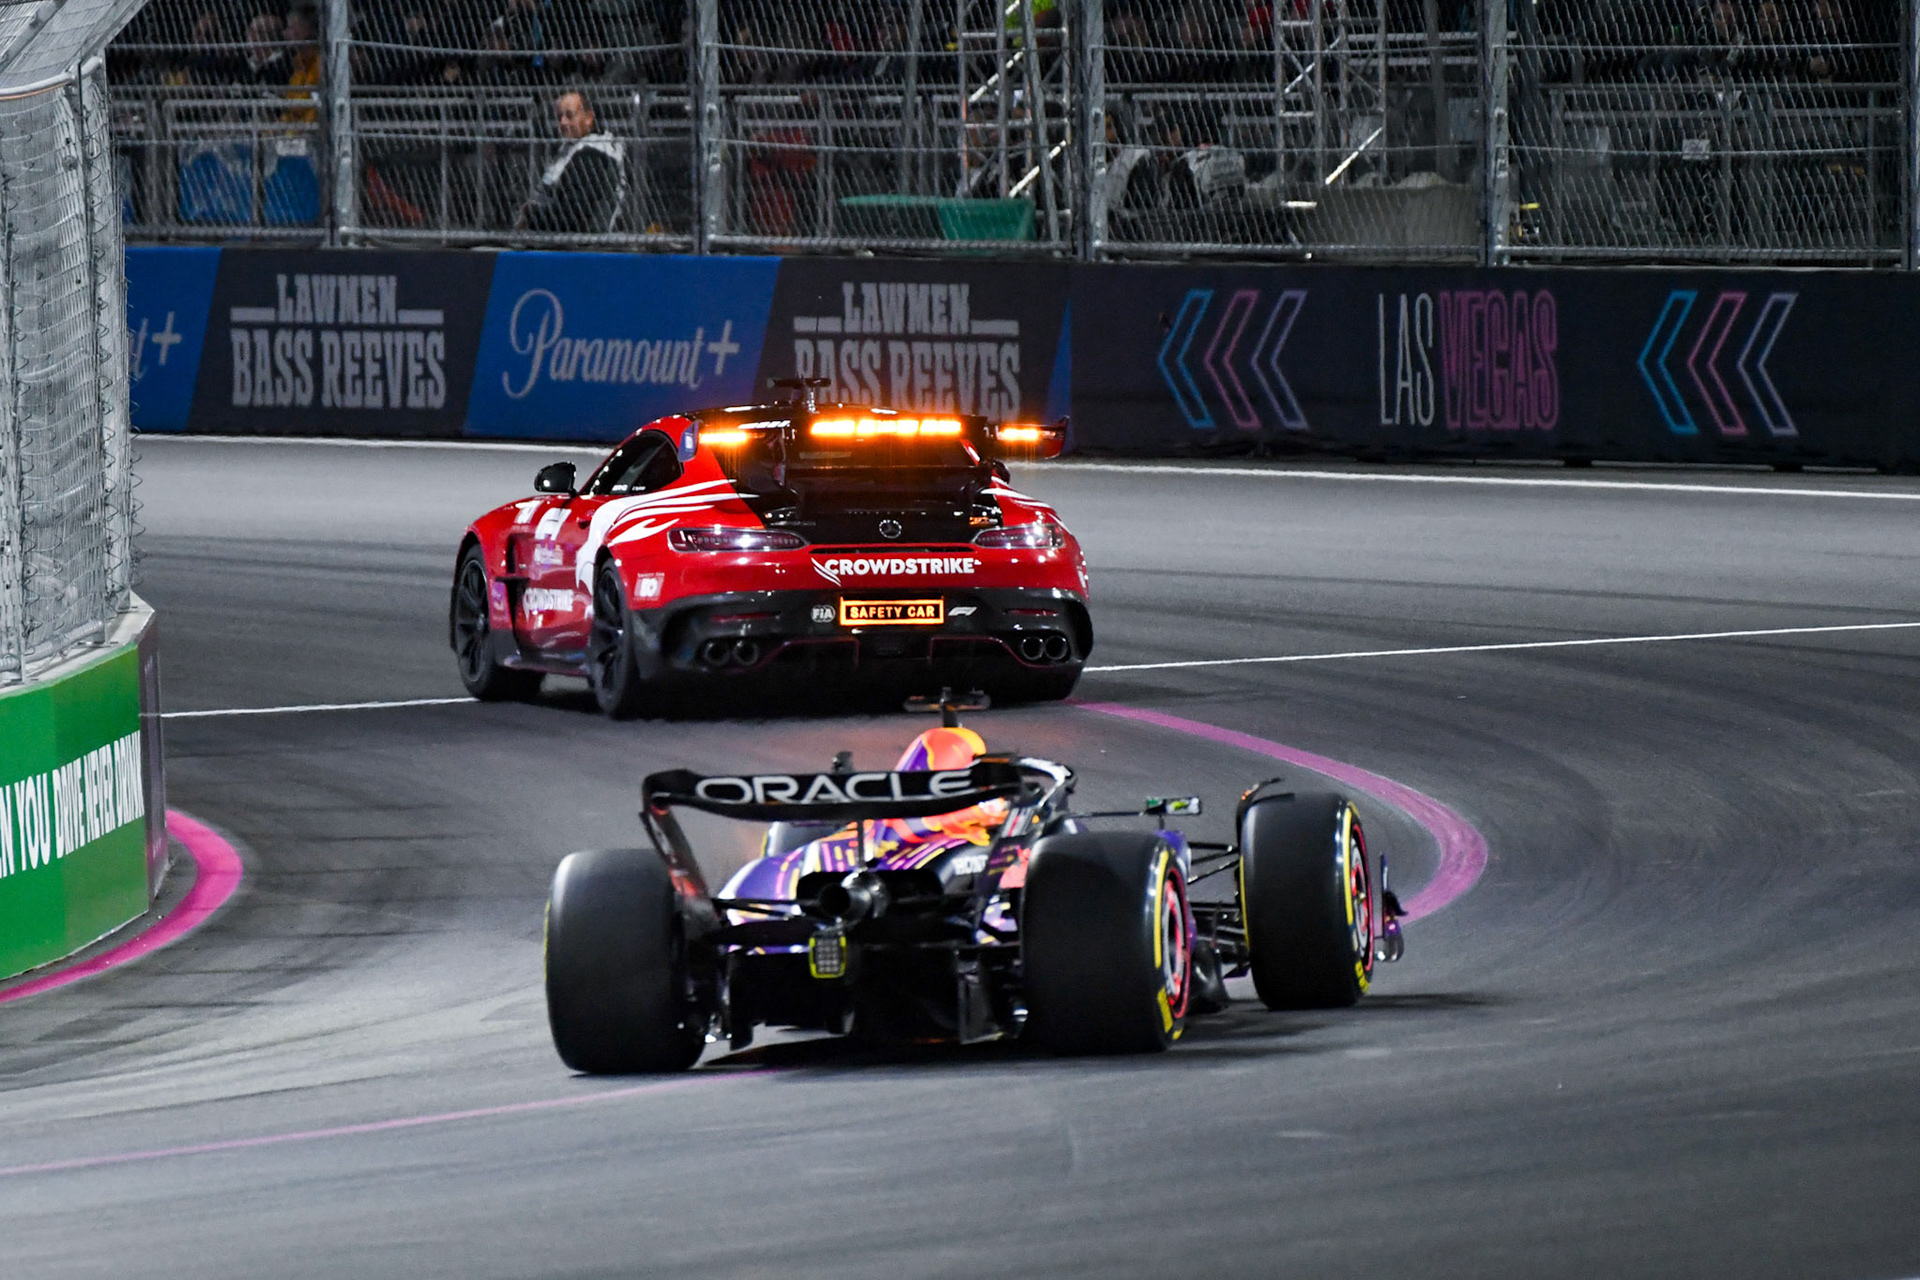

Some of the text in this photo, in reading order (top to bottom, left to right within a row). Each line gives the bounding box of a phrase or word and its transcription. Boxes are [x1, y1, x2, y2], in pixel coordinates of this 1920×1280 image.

[277, 273, 398, 324] LAWMEN
[842, 282, 970, 333] LAWMEN
[230, 328, 314, 407] BASS
[320, 330, 447, 409] REEVES
[502, 288, 740, 398] Paramount+
[1379, 289, 1559, 431] LAS VEGAS
[887, 341, 1020, 425] REEVES
[823, 557, 976, 576] CROWDSTRIKE
[850, 605, 936, 619] SAFETY CAR
[14, 772, 51, 872] YOU
[52, 757, 86, 859] DRIVE
[83, 743, 116, 844] NEVER
[695, 769, 978, 805] ORACLE
